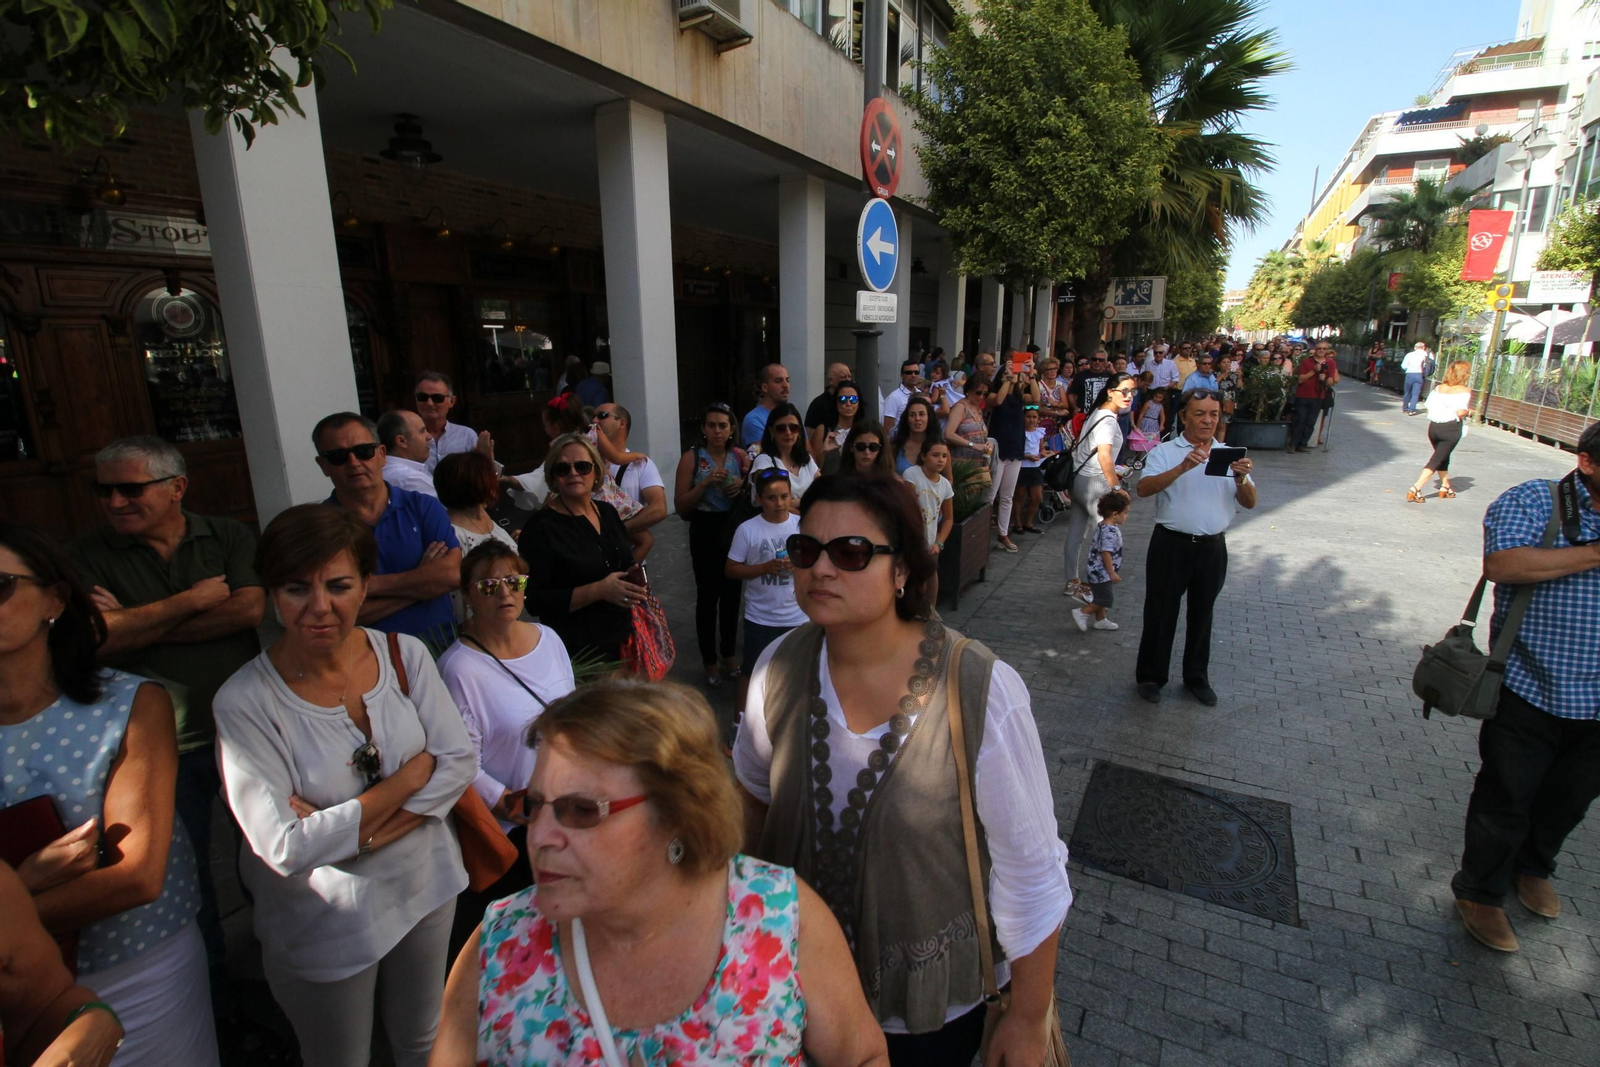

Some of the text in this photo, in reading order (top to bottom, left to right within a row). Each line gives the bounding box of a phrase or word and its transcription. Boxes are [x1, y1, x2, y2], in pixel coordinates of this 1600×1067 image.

[877, 186, 888, 196] GRUA
[111, 218, 207, 245] STOU
[145, 349, 180, 358] RED
[1565, 494, 1573, 520] DIGITAL
[758, 538, 786, 553] AW
